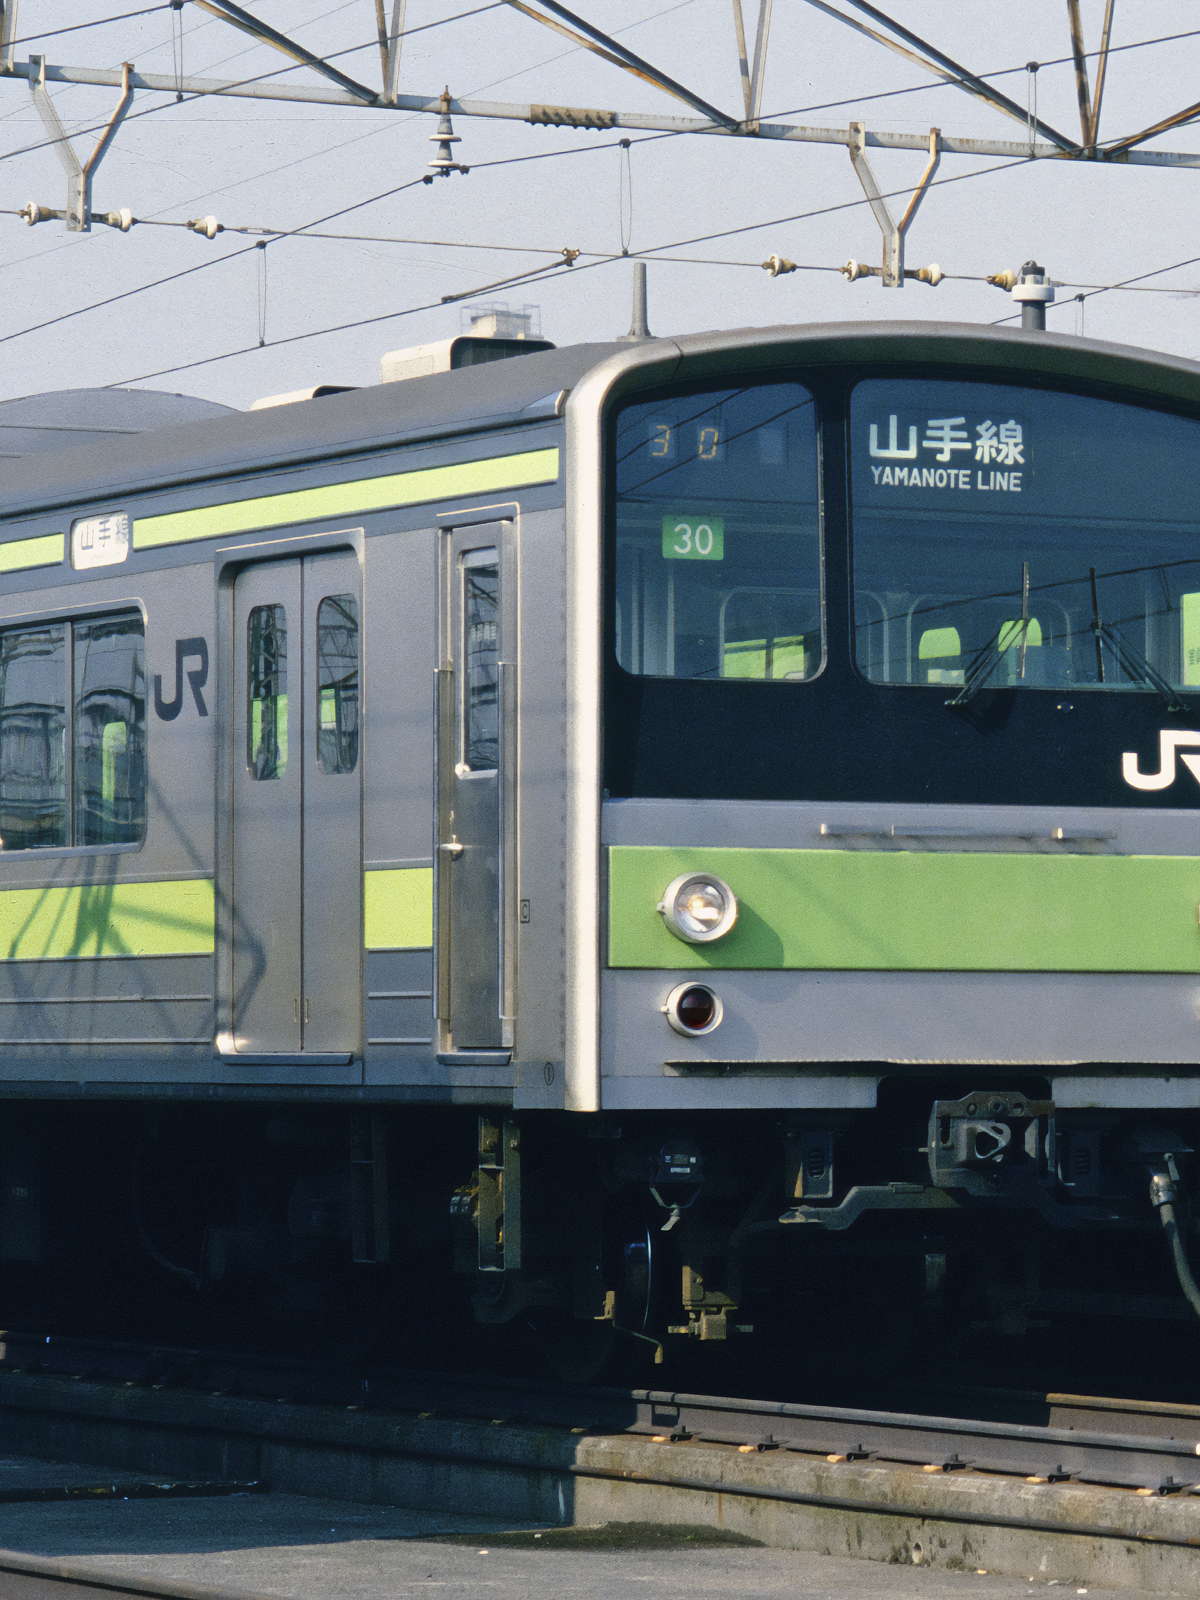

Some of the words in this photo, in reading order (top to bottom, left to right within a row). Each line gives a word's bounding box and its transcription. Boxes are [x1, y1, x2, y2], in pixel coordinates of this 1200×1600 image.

[869, 414, 1025, 465] 山手線
[871, 466, 971, 489] YAMANOTE
[977, 470, 1023, 492] LINE
[673, 523, 714, 556] 30
[153, 636, 209, 722] JR
